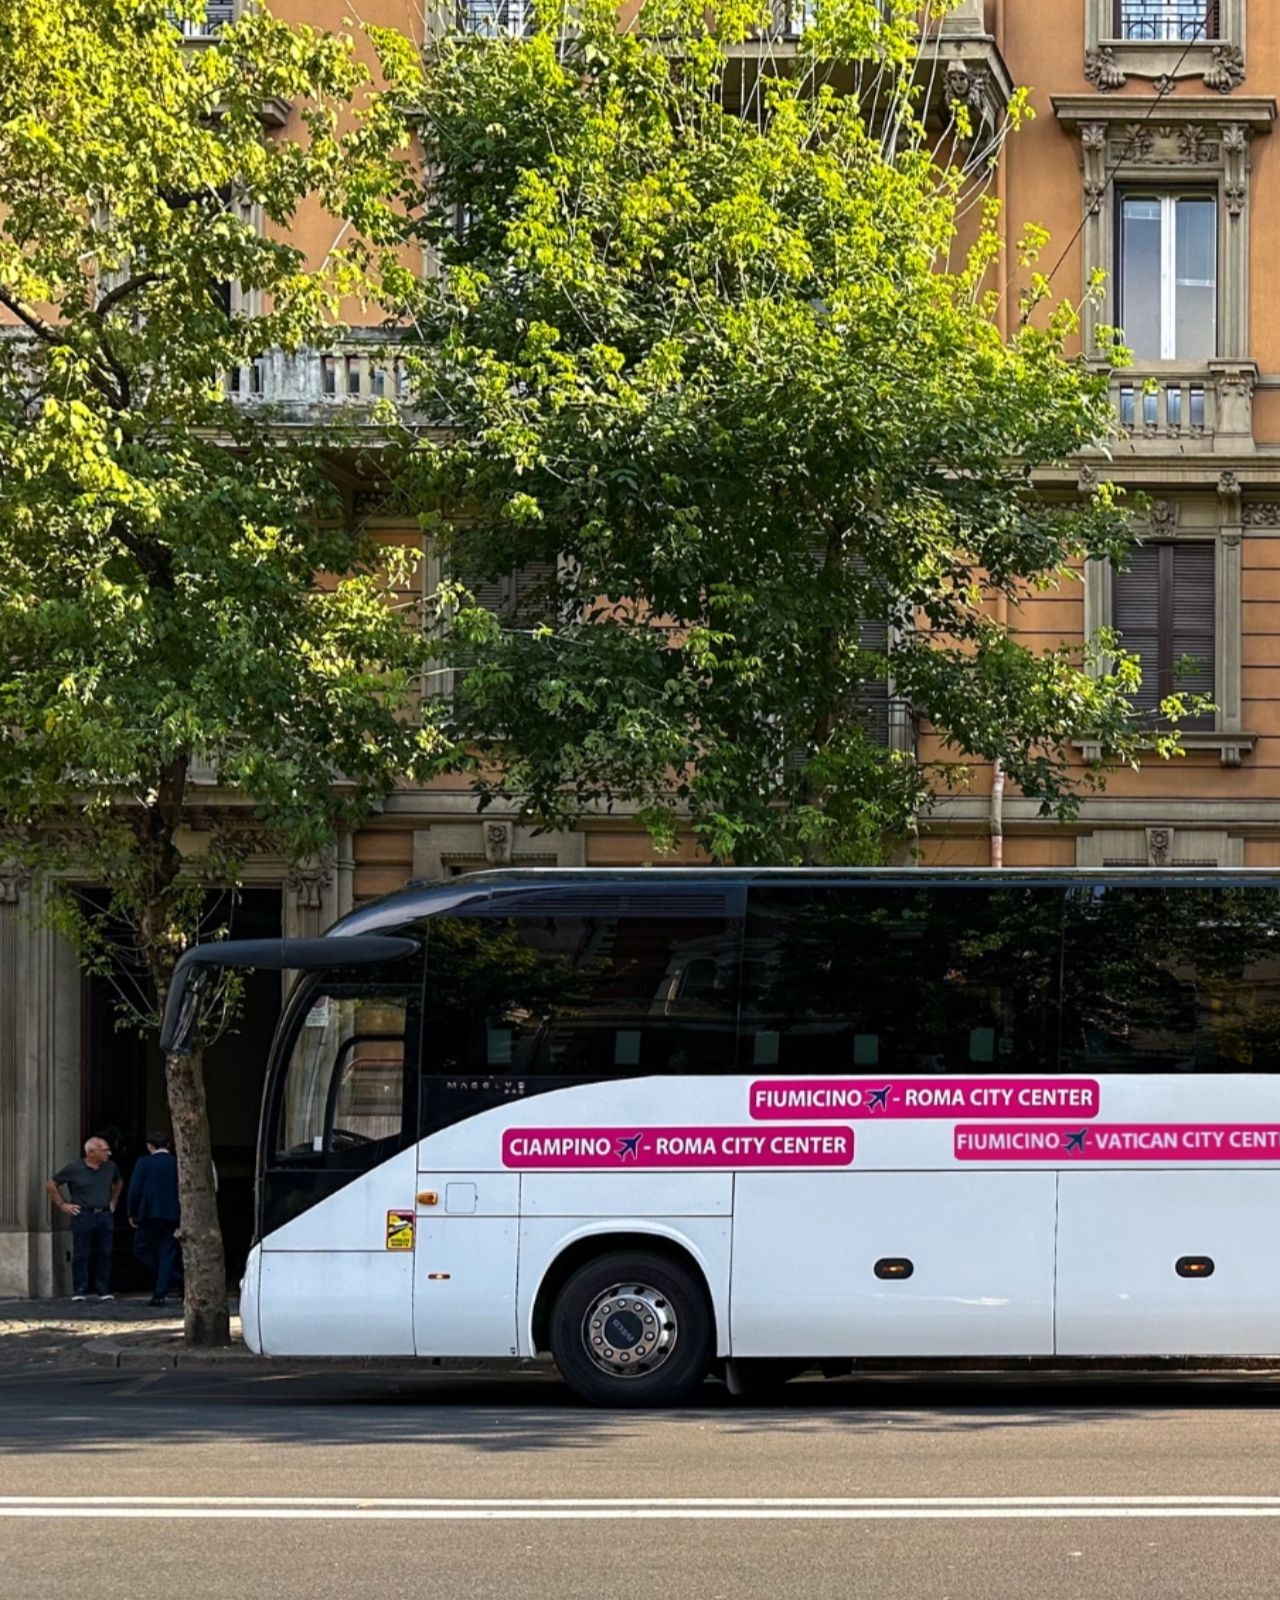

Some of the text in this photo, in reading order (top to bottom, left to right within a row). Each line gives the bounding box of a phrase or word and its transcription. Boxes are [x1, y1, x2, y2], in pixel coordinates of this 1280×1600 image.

[755, 1089, 862, 1108] FIUMICINO
[904, 1088, 965, 1106] ROMA
[969, 1088, 1014, 1106] CITY
[1018, 1088, 1094, 1106] CENTER
[509, 1137, 611, 1156] CIAMPINO
[656, 1137, 717, 1155] ROMA
[721, 1137, 766, 1155] CITY
[770, 1136, 846, 1154] CENTER
[957, 1132, 1060, 1150] FIUMICINO
[1095, 1132, 1178, 1149] VATICAN
[1182, 1131, 1224, 1148] CITY
